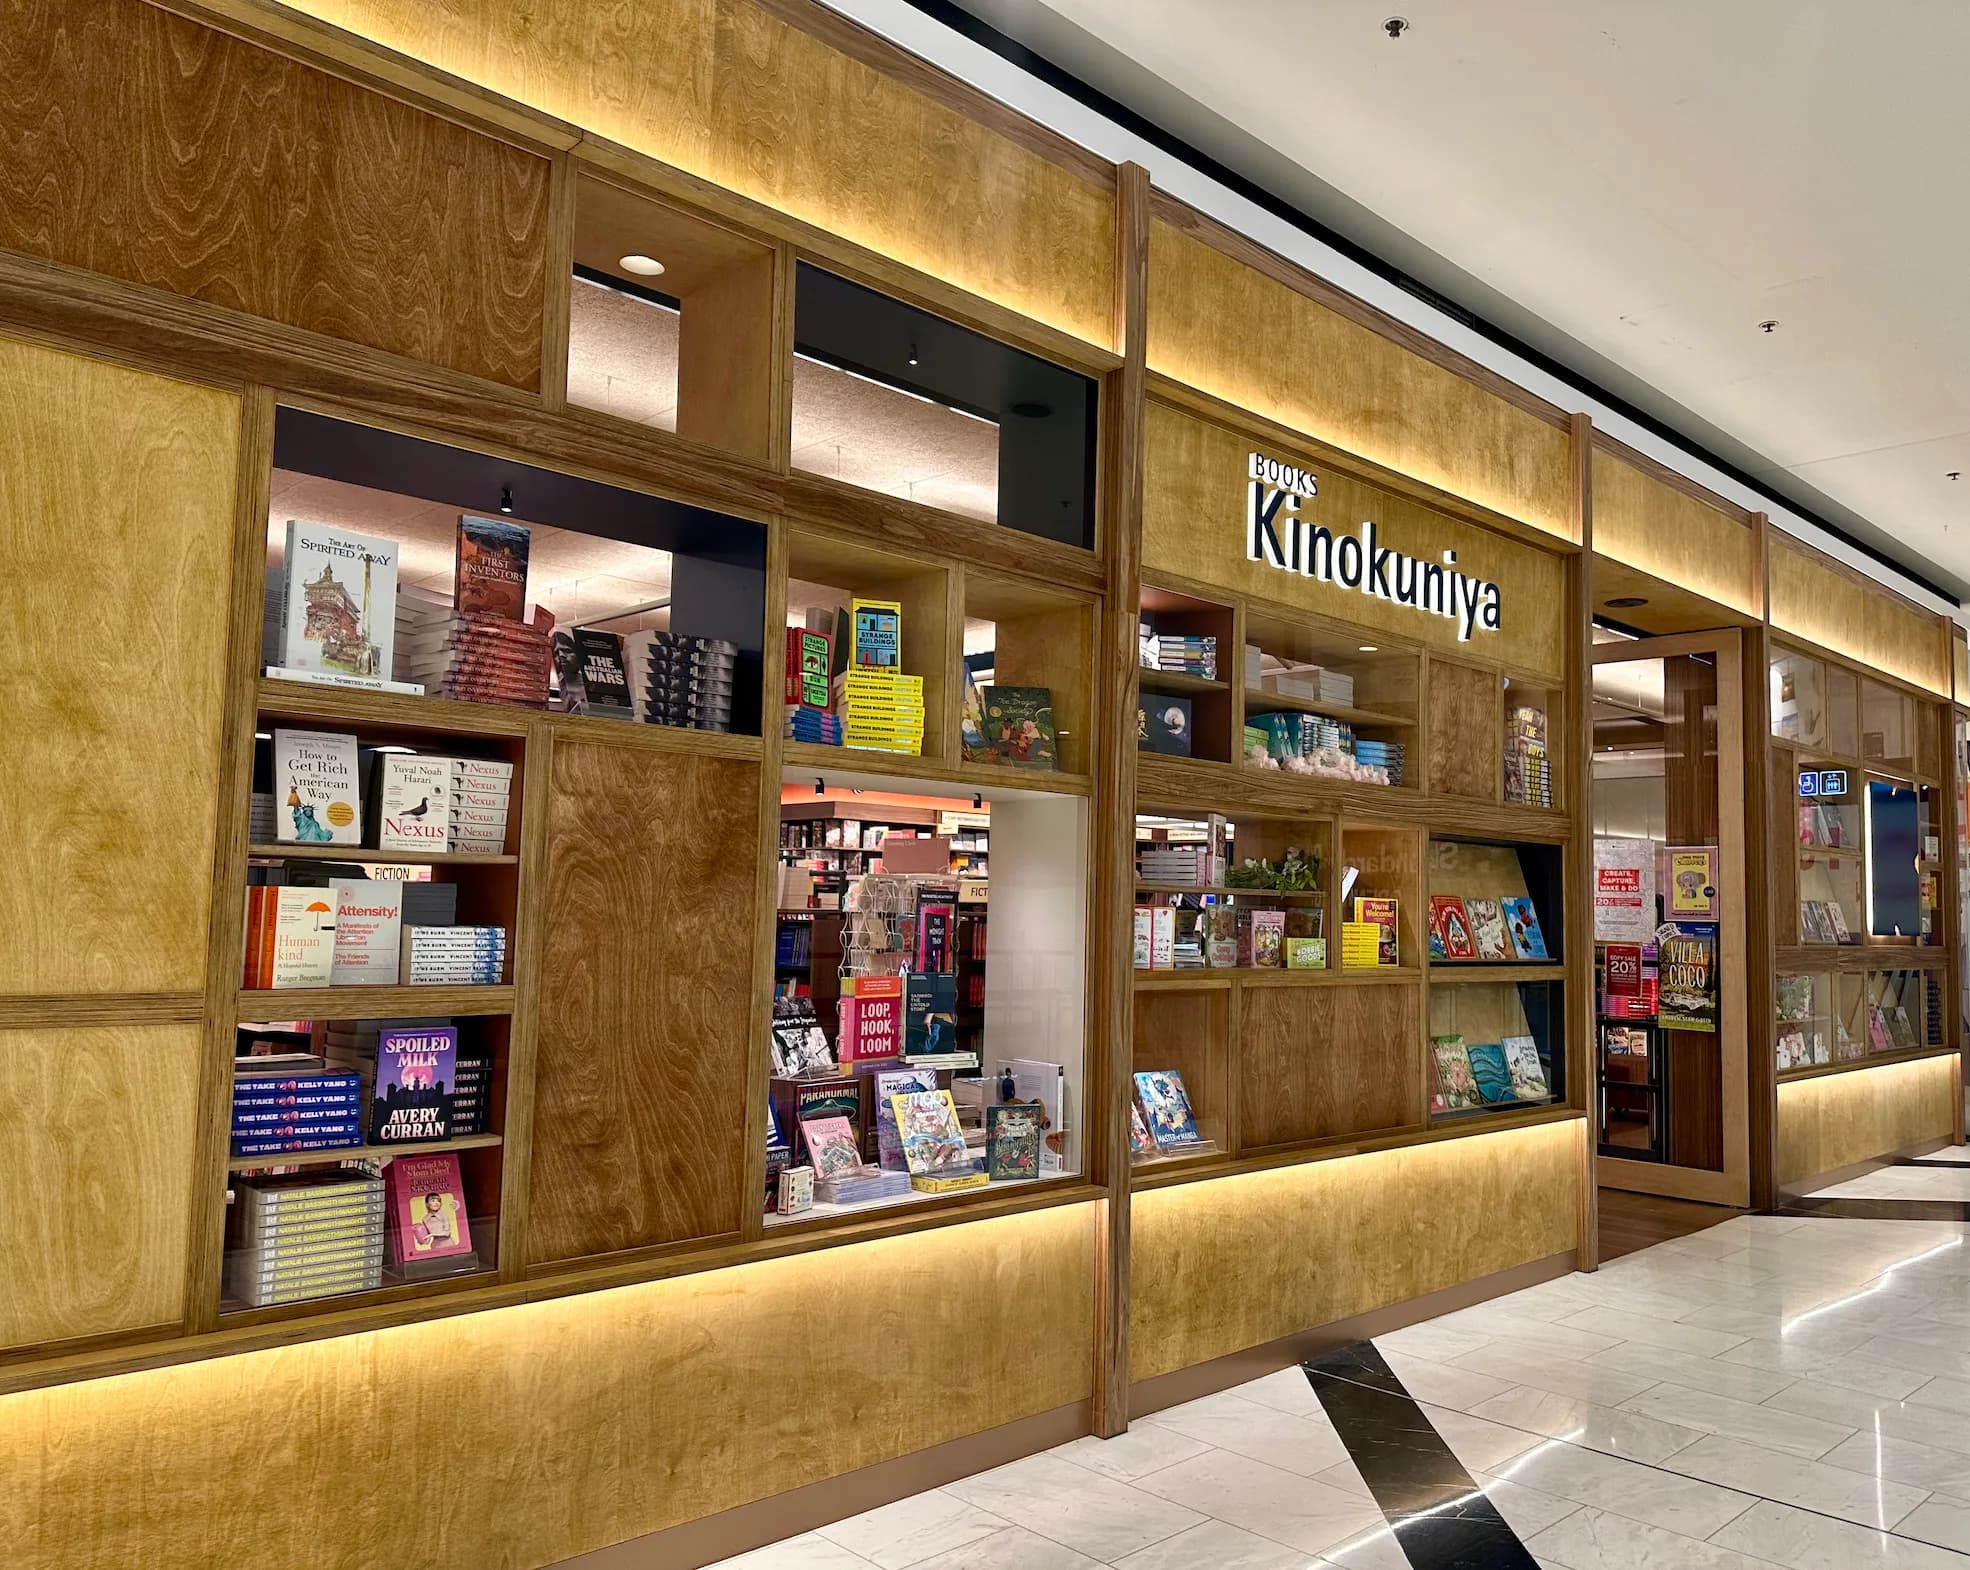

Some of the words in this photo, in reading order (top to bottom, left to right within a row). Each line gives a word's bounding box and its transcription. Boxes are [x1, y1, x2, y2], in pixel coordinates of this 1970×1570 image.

[1249, 452, 1318, 498] BOOKS
[300, 538, 355, 559] SPIRITED
[482, 556, 509, 569] FIRST
[1246, 481, 1501, 642] Kinokuniya
[464, 563, 525, 582] INVENTORS
[858, 638, 896, 646] BUILDINGS
[861, 631, 893, 640] STRANGE
[587, 655, 615, 669] THE
[583, 665, 623, 675] AUSTRALIAN
[584, 670, 625, 686] WARS
[299, 749, 322, 760] How
[288, 759, 312, 772] Get
[318, 761, 347, 775] Rich
[393, 764, 417, 774] Yuval
[419, 766, 442, 776] Noah
[470, 763, 500, 774] Nexus
[289, 775, 348, 790] American
[404, 774, 432, 784] Harari
[467, 779, 497, 790] Nexus
[307, 787, 333, 802] Way
[466, 795, 496, 806] Nexus
[464, 810, 494, 822] Nexus
[384, 817, 445, 838] Nexus
[463, 826, 493, 837] Nexus
[461, 842, 491, 853] Nexus
[375, 867, 410, 881] FICTION
[337, 905, 398, 919] Attensity!
[1371, 902, 1390, 910] You're
[279, 934, 320, 947] Human
[278, 947, 303, 961] kind
[1670, 941, 1704, 964] VILLA
[1610, 960, 1637, 974] 20%
[277, 974, 297, 983] Rutger
[1669, 964, 1706, 988] COCO
[861, 1002, 891, 1019] LOOP,
[861, 1019, 895, 1036] HOOK,
[385, 1036, 451, 1054] SPOILED
[860, 1036, 891, 1054] LOOM
[397, 1052, 439, 1068] MILK
[455, 1060, 481, 1068] CURRAN
[455, 1073, 480, 1081] CURRAN
[323, 1095, 346, 1103] YANG
[800, 1087, 859, 1106] PARANORMAL
[388, 1107, 440, 1125] AVERY
[380, 1121, 446, 1140] CURRAN
[1157, 1133, 1176, 1142] MASTER
[1180, 1131, 1198, 1140] MANGA
[771, 1151, 789, 1160] PAPER
[417, 1160, 437, 1170] Glad
[438, 1159, 450, 1169] My
[406, 1169, 429, 1178] Mom
[430, 1167, 450, 1176] Died
